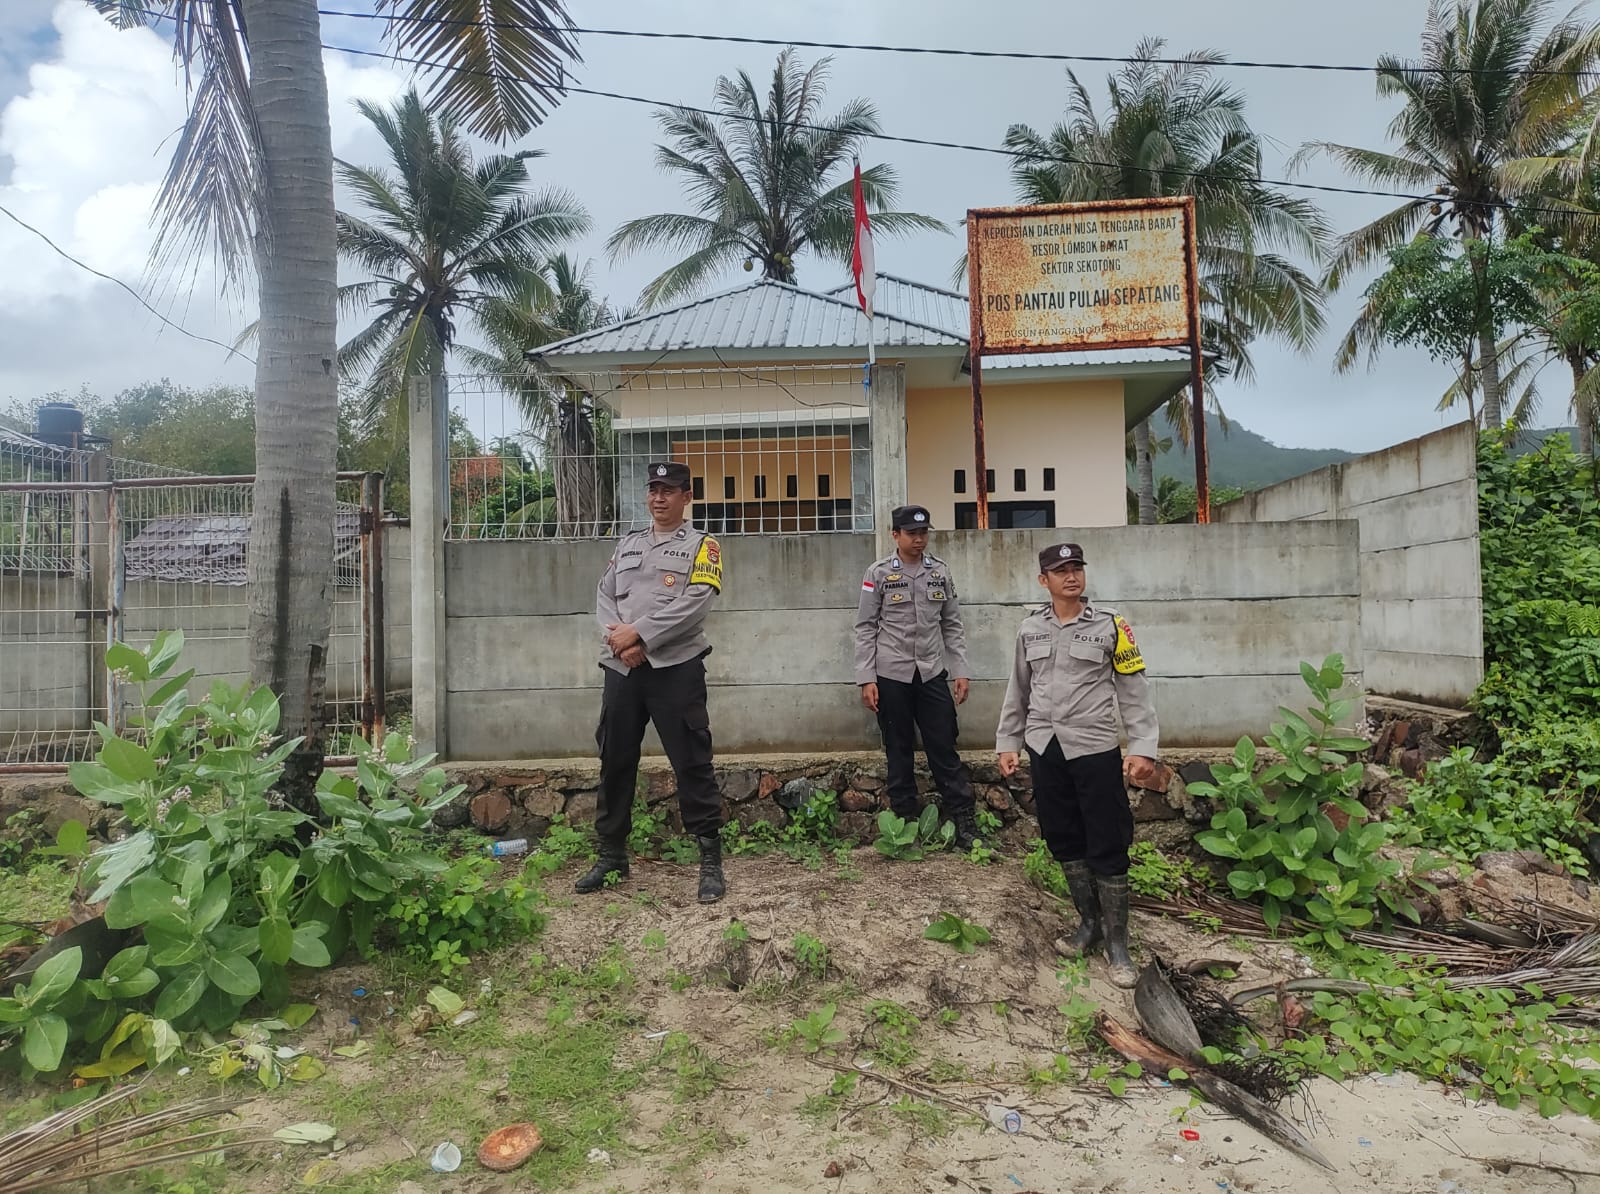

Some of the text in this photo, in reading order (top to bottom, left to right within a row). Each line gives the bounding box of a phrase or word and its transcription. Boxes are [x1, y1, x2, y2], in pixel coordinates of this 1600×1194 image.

[984, 216, 1177, 240] KEPOLISIAN DAERAH NUSA TENGGARA BARAT
[1032, 239, 1129, 257] RESOR LOMBOK BARAT
[1041, 258, 1121, 275] SEKTOR SEKOTONG
[987, 284, 1180, 312] POS PANTAU PULAU SEPATANG
[1004, 329, 1037, 338] DUSUN
[1039, 326, 1092, 337] PANGGANG
[663, 550, 690, 559] POLRI
[1074, 633, 1104, 643] POLRI
